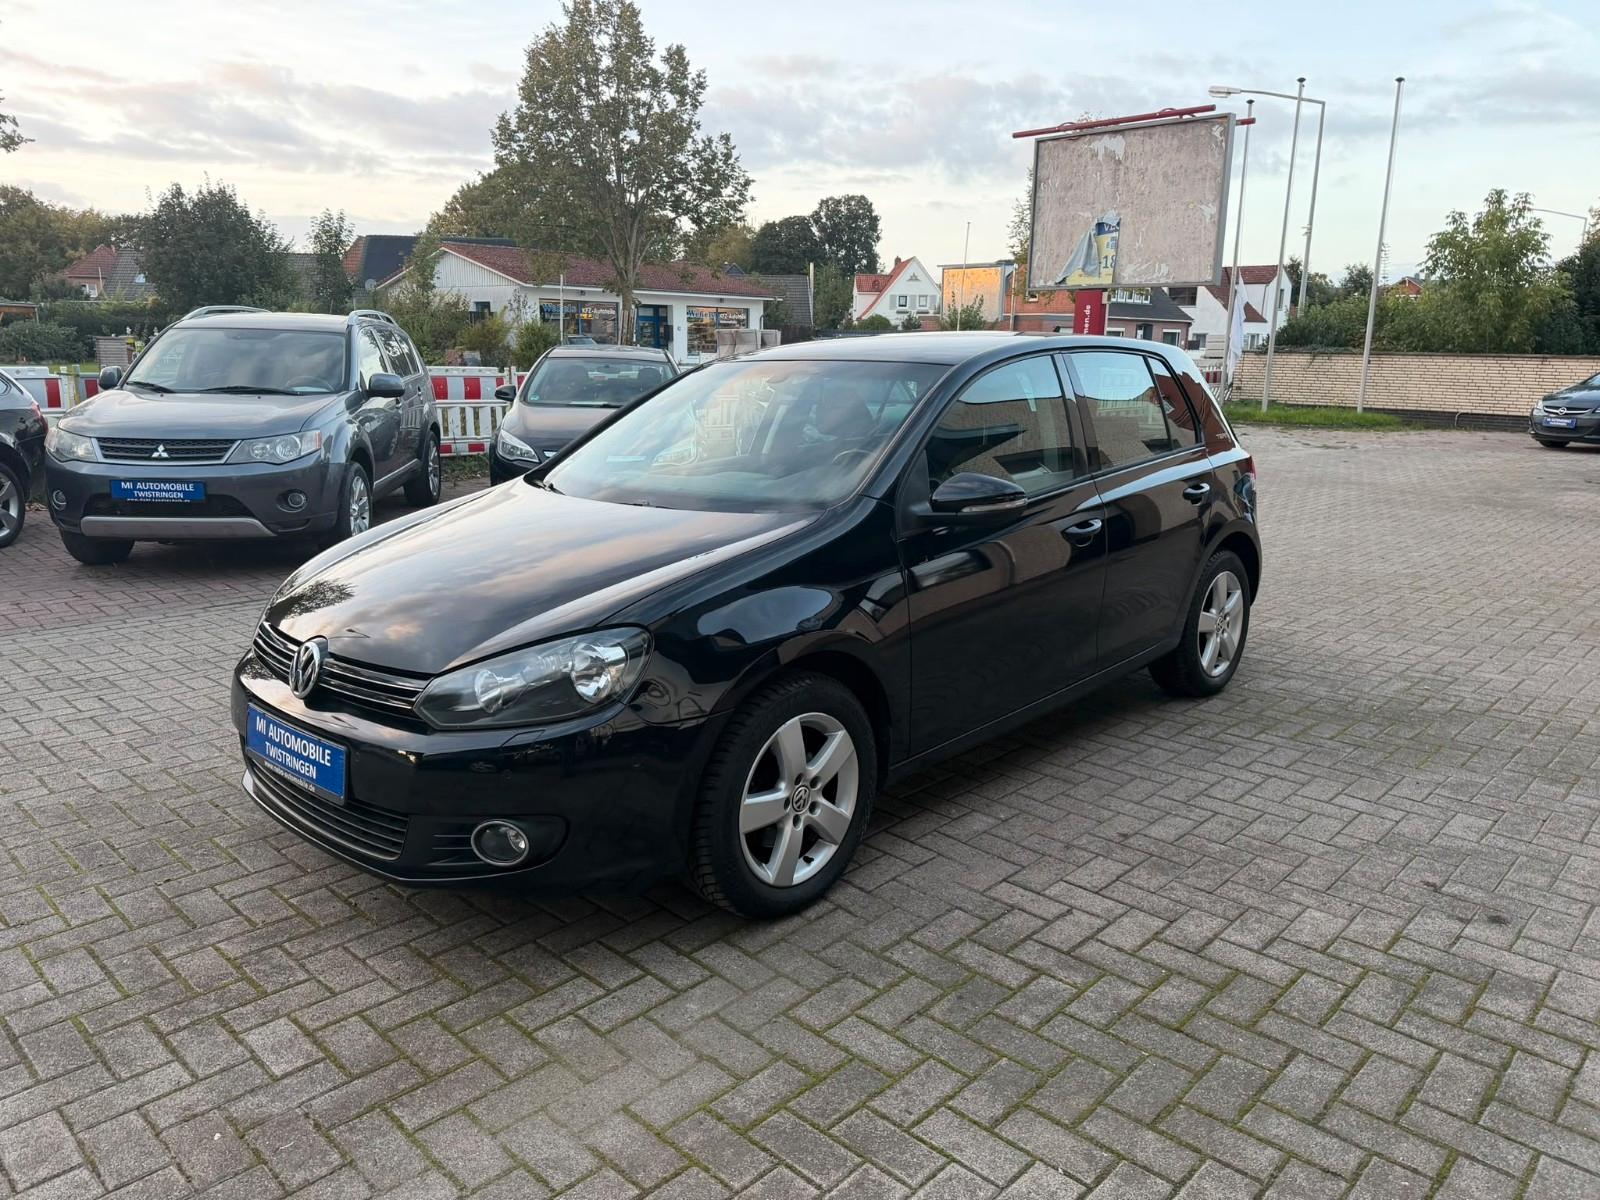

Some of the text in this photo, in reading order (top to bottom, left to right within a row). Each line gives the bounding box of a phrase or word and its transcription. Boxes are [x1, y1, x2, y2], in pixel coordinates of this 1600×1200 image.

[121, 481, 195, 492] MI AUTOMOBILE
[133, 490, 184, 499] TWISTRINGEN
[256, 715, 332, 767] MI AUTOMOBILE
[265, 741, 317, 780] TWISTRINGEN
